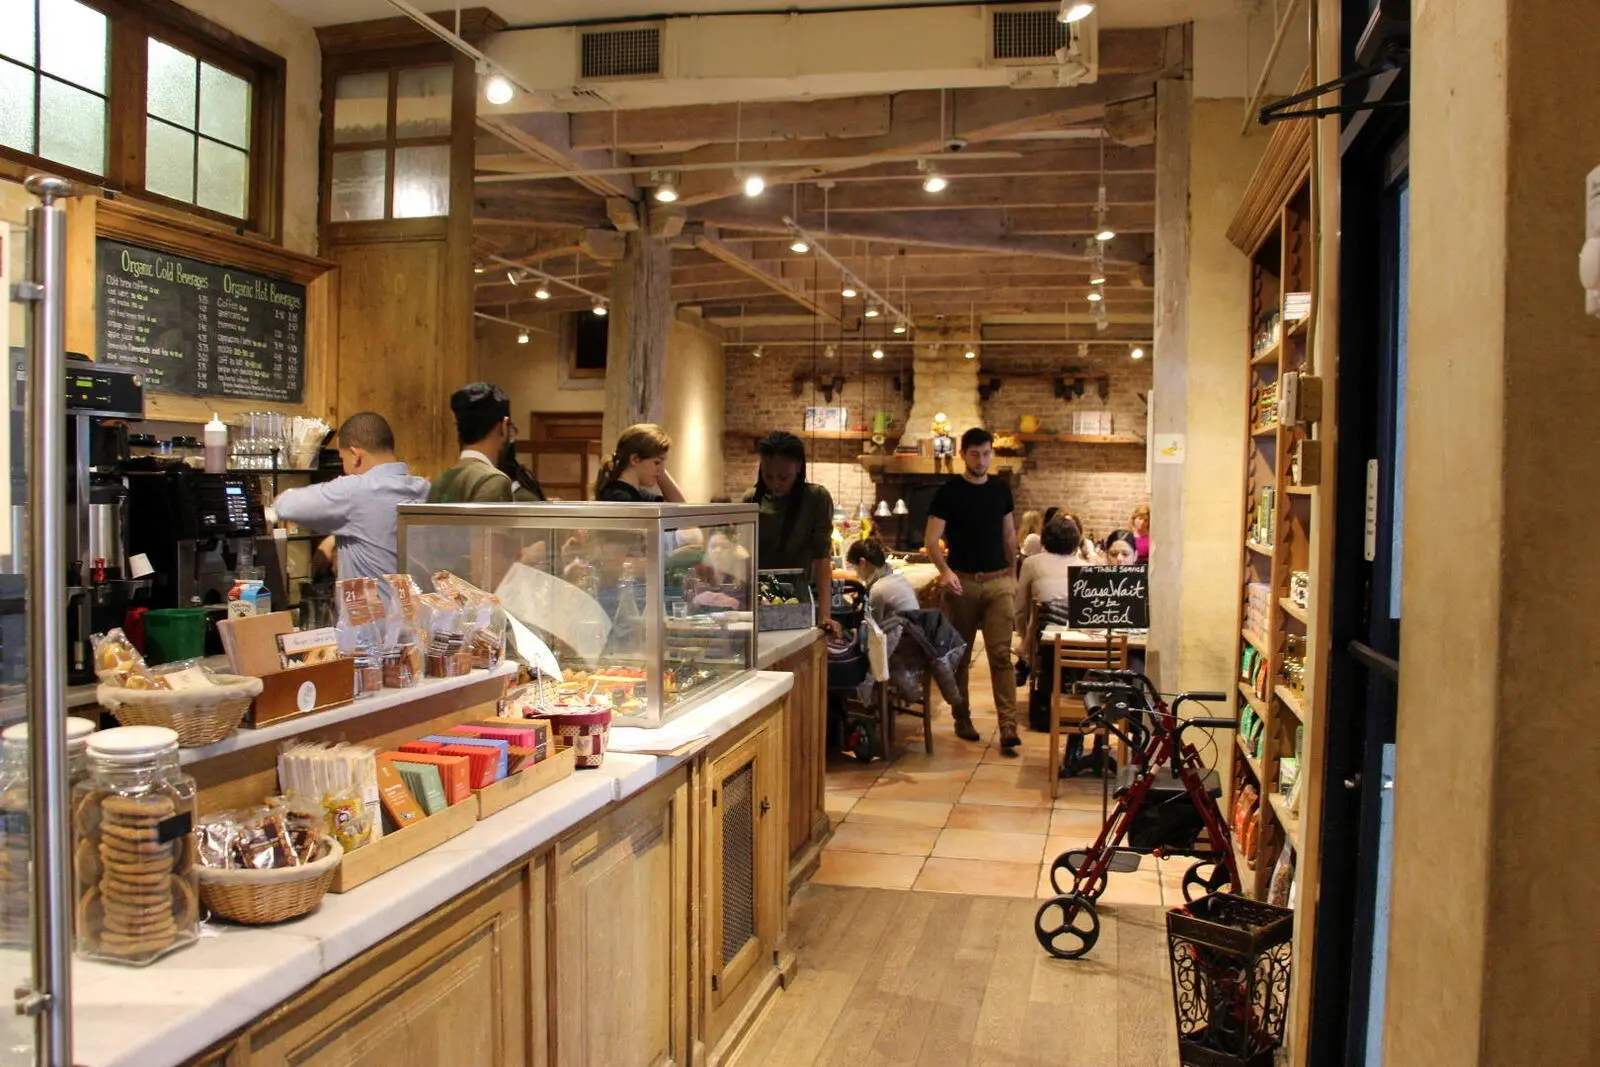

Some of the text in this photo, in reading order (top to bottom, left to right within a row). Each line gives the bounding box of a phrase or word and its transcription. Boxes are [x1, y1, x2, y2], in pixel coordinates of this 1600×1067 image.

[121, 249, 209, 290] Organic Cold Beverages
[223, 273, 302, 310] Organic Hot Beverages
[344, 590, 356, 602] 21
[1073, 577, 1145, 599] Please Wait
[1091, 597, 1120, 607] to be
[1078, 605, 1133, 625] Seated
